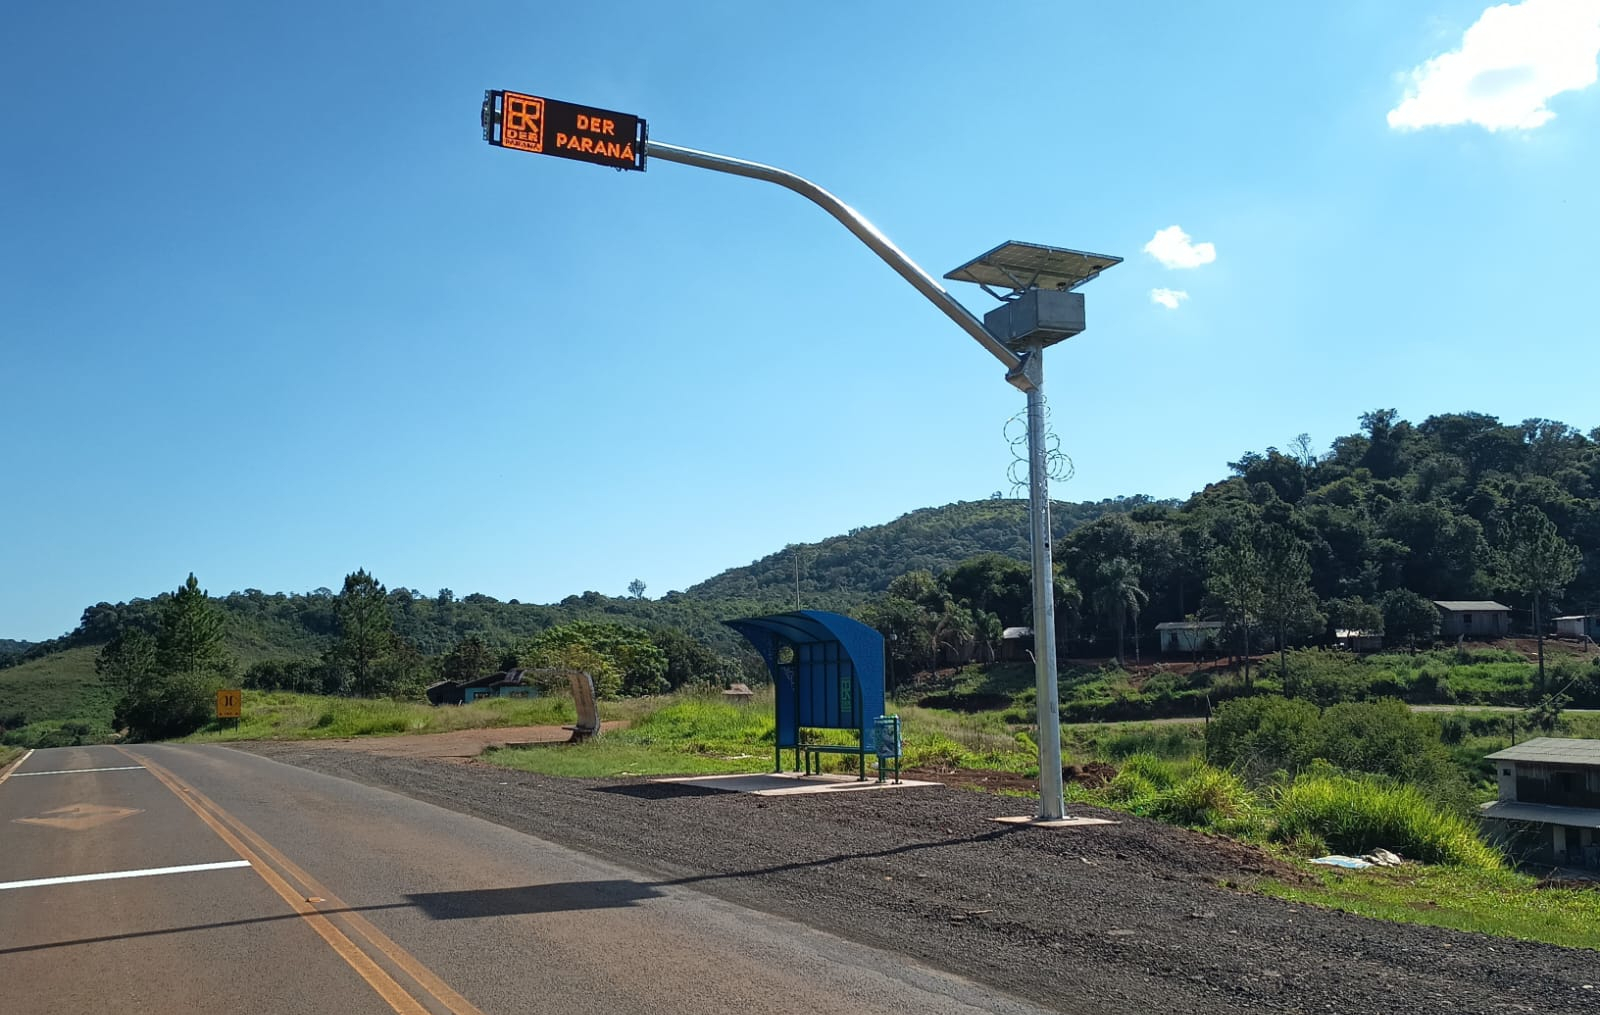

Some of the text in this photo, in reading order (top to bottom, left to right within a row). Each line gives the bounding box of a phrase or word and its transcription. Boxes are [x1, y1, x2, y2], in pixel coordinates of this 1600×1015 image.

[576, 114, 615, 135] DER
[507, 129, 538, 142] DER
[556, 132, 635, 161] PARANÁ
